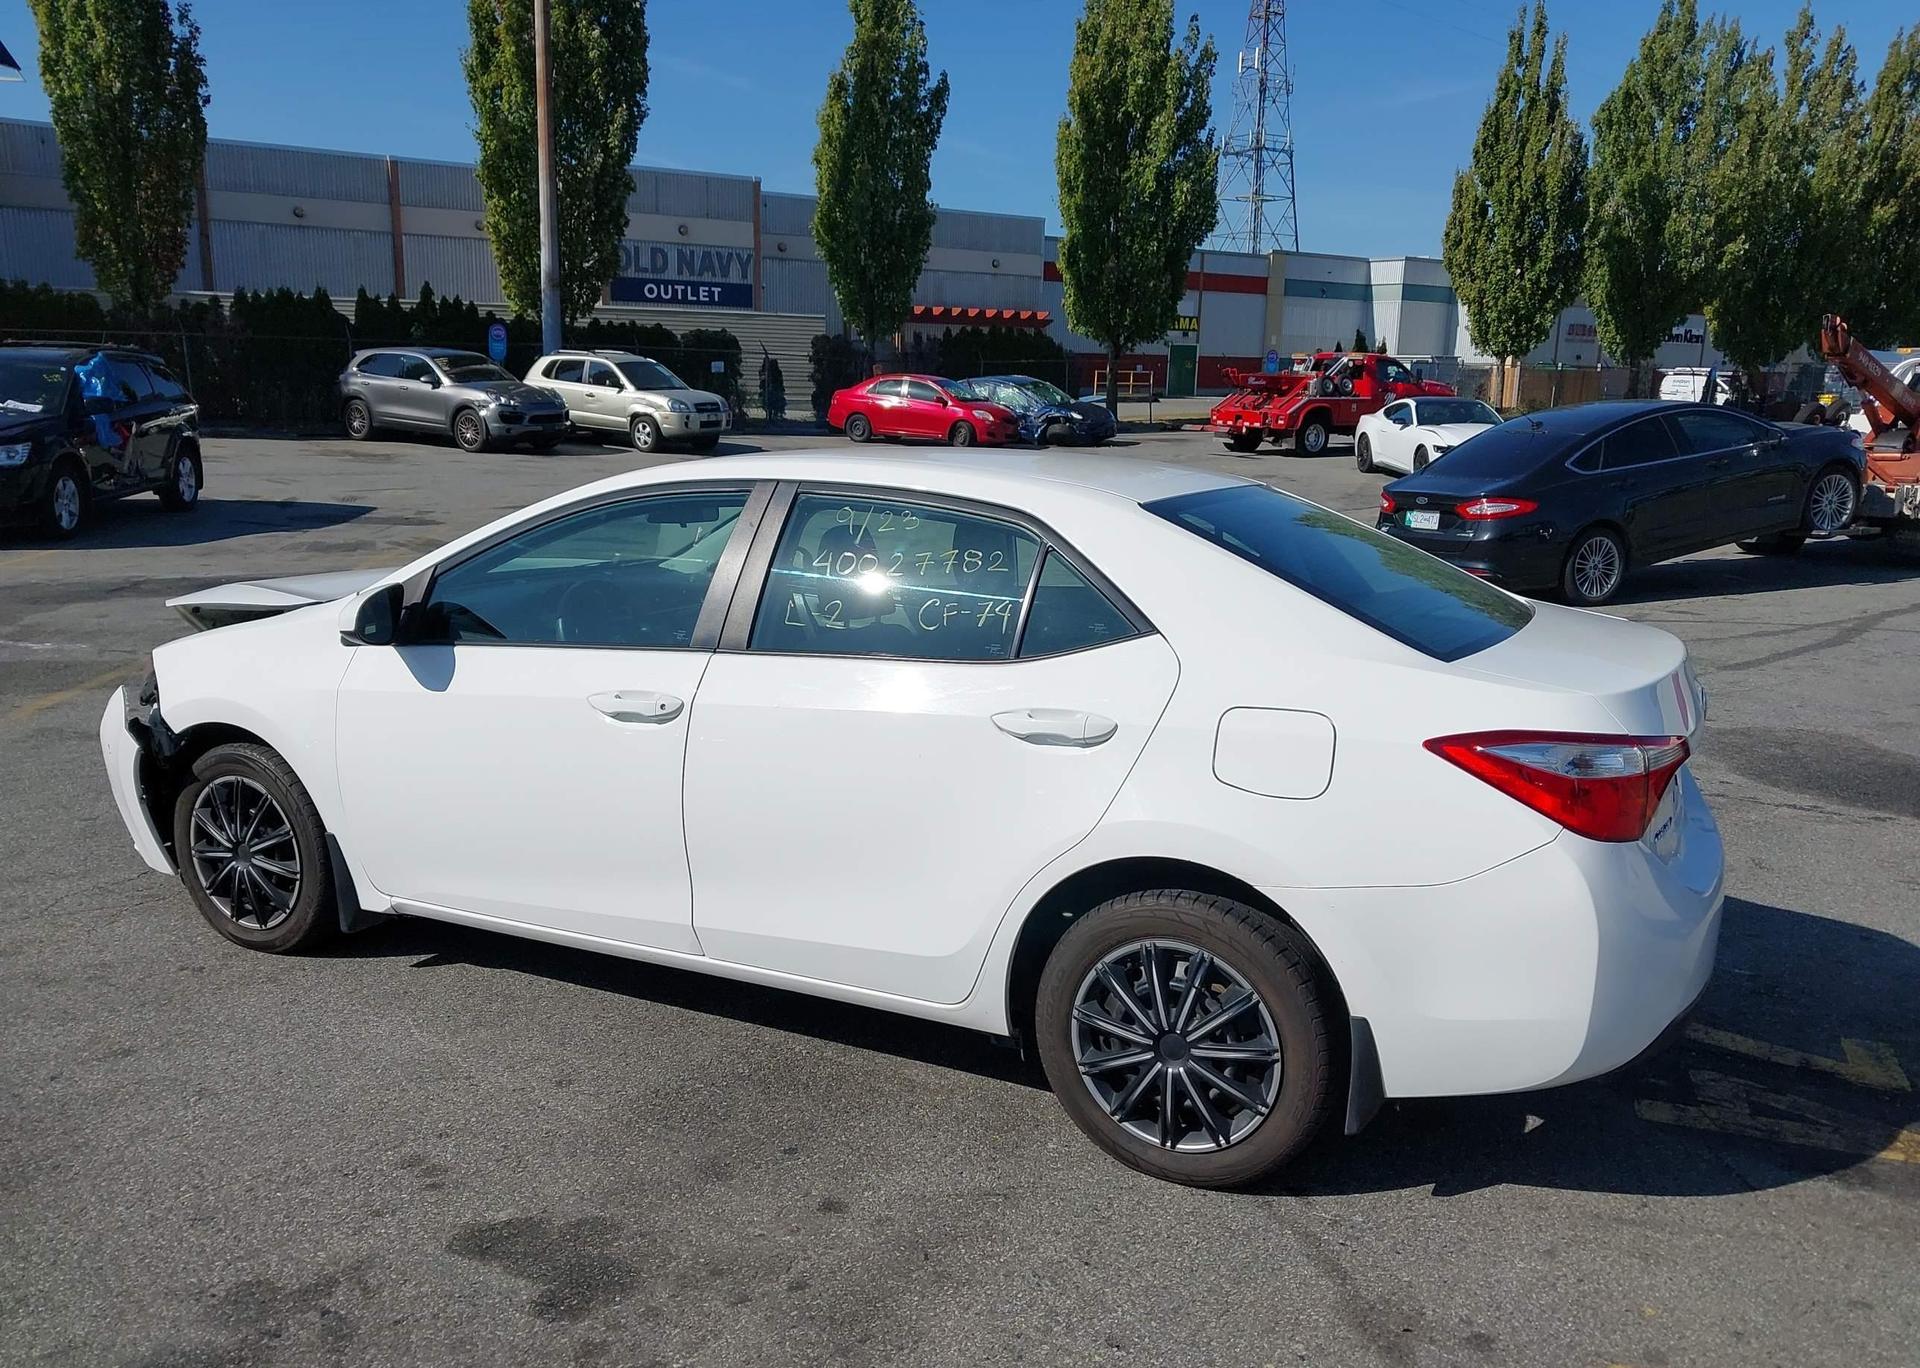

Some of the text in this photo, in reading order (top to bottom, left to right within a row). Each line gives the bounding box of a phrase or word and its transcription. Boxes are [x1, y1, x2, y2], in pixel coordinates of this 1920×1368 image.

[676, 248, 753, 280] NAVY
[643, 283, 722, 302] OUTLET
[1683, 328, 1704, 344] Klein
[835, 505, 921, 545] 9/23
[812, 549, 1009, 577] 40027782
[918, 598, 1013, 634] CF-74
